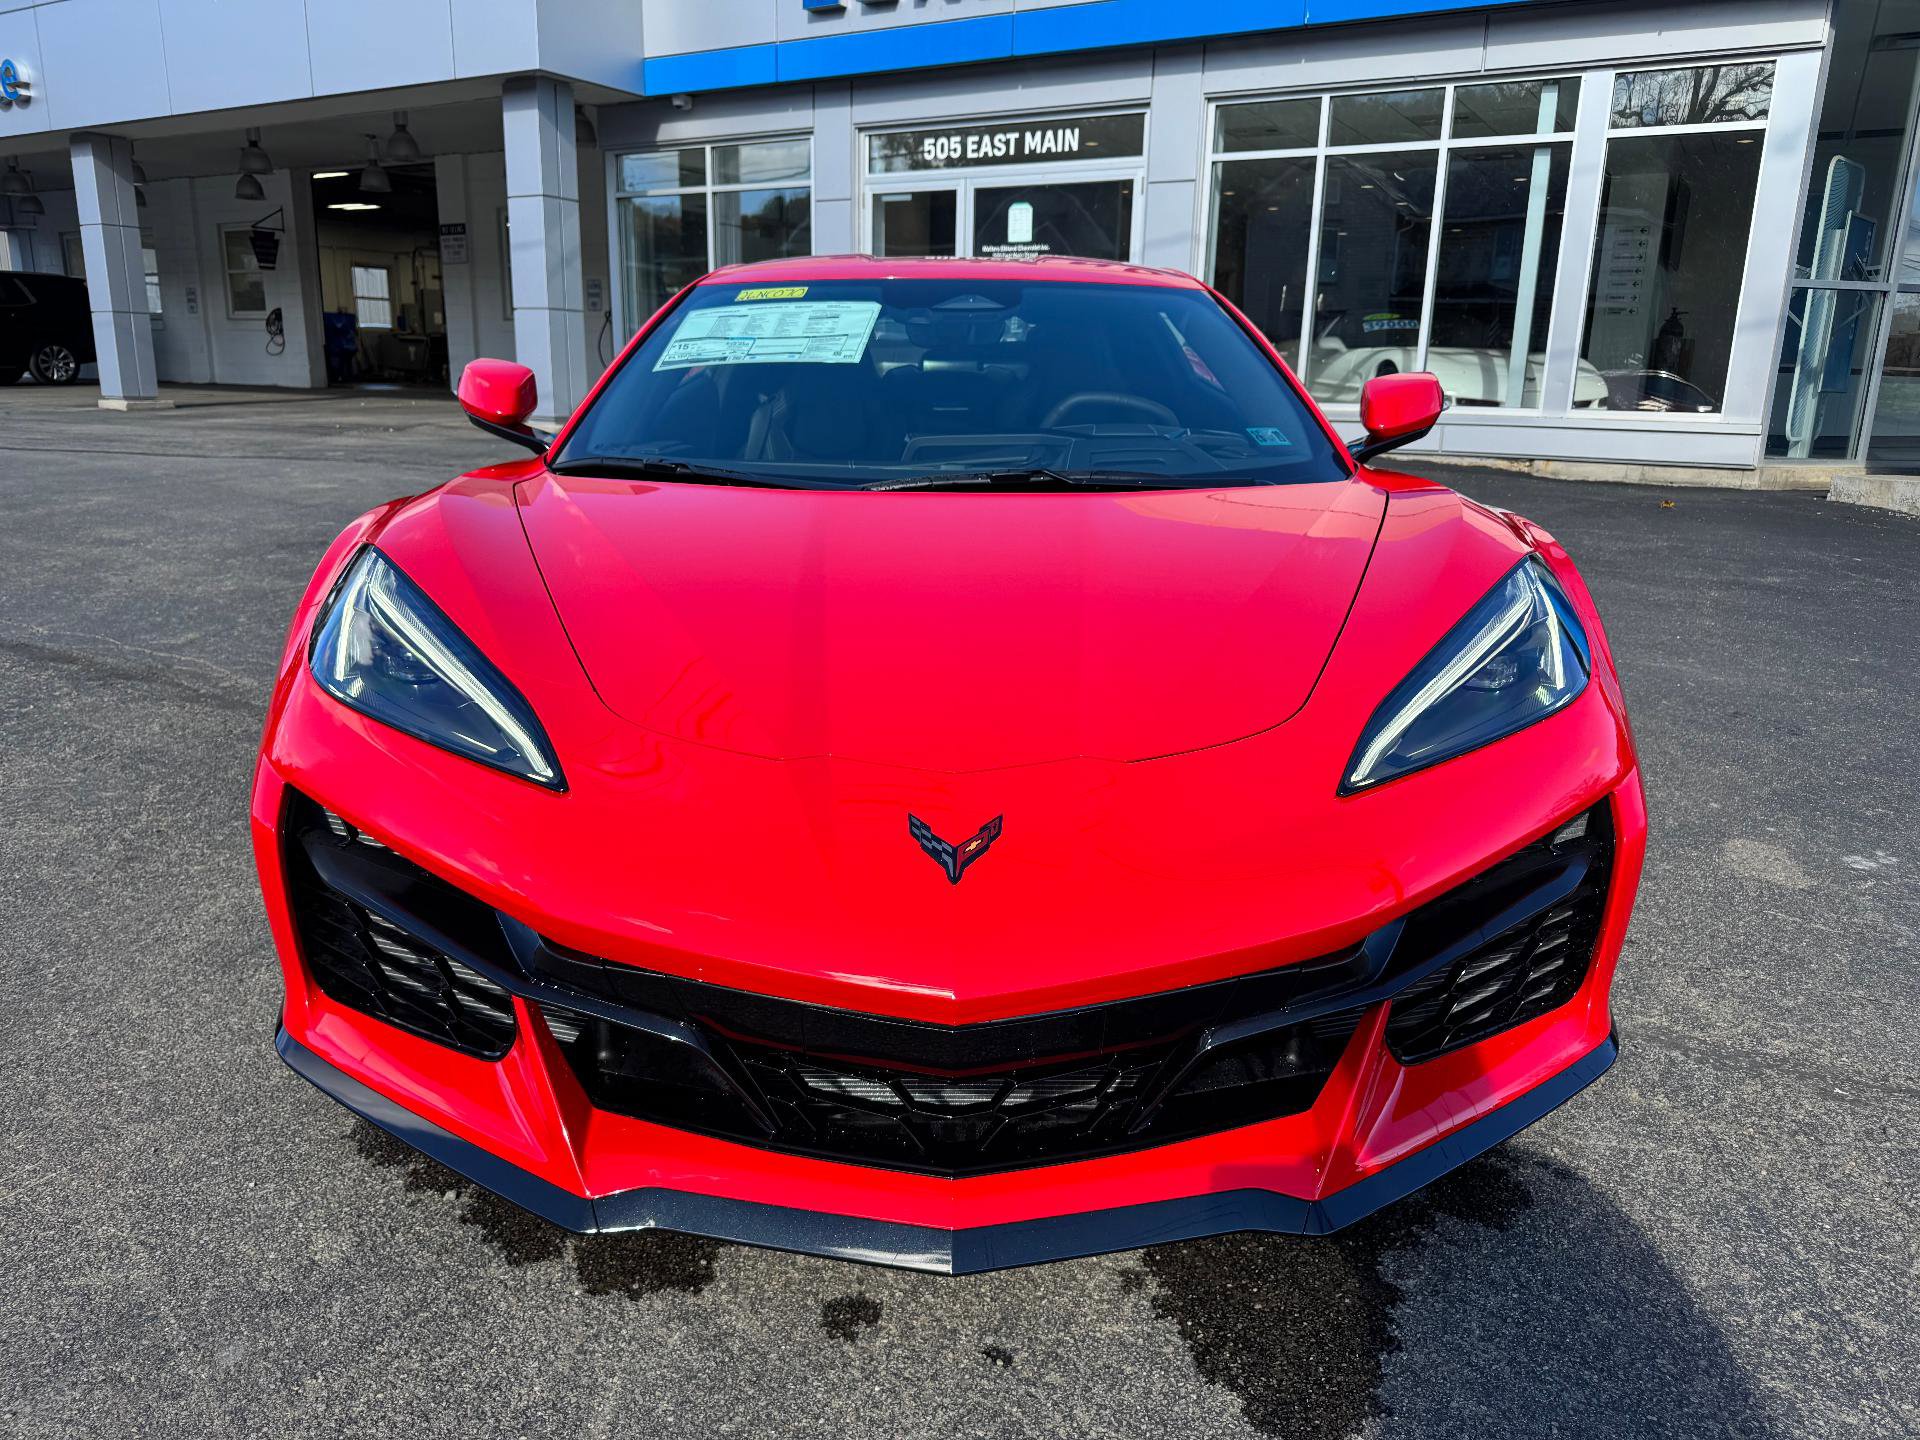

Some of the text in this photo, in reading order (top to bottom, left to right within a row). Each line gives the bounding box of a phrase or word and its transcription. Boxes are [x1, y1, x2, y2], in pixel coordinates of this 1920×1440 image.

[923, 127, 1080, 161] 505 EAST MAIN
